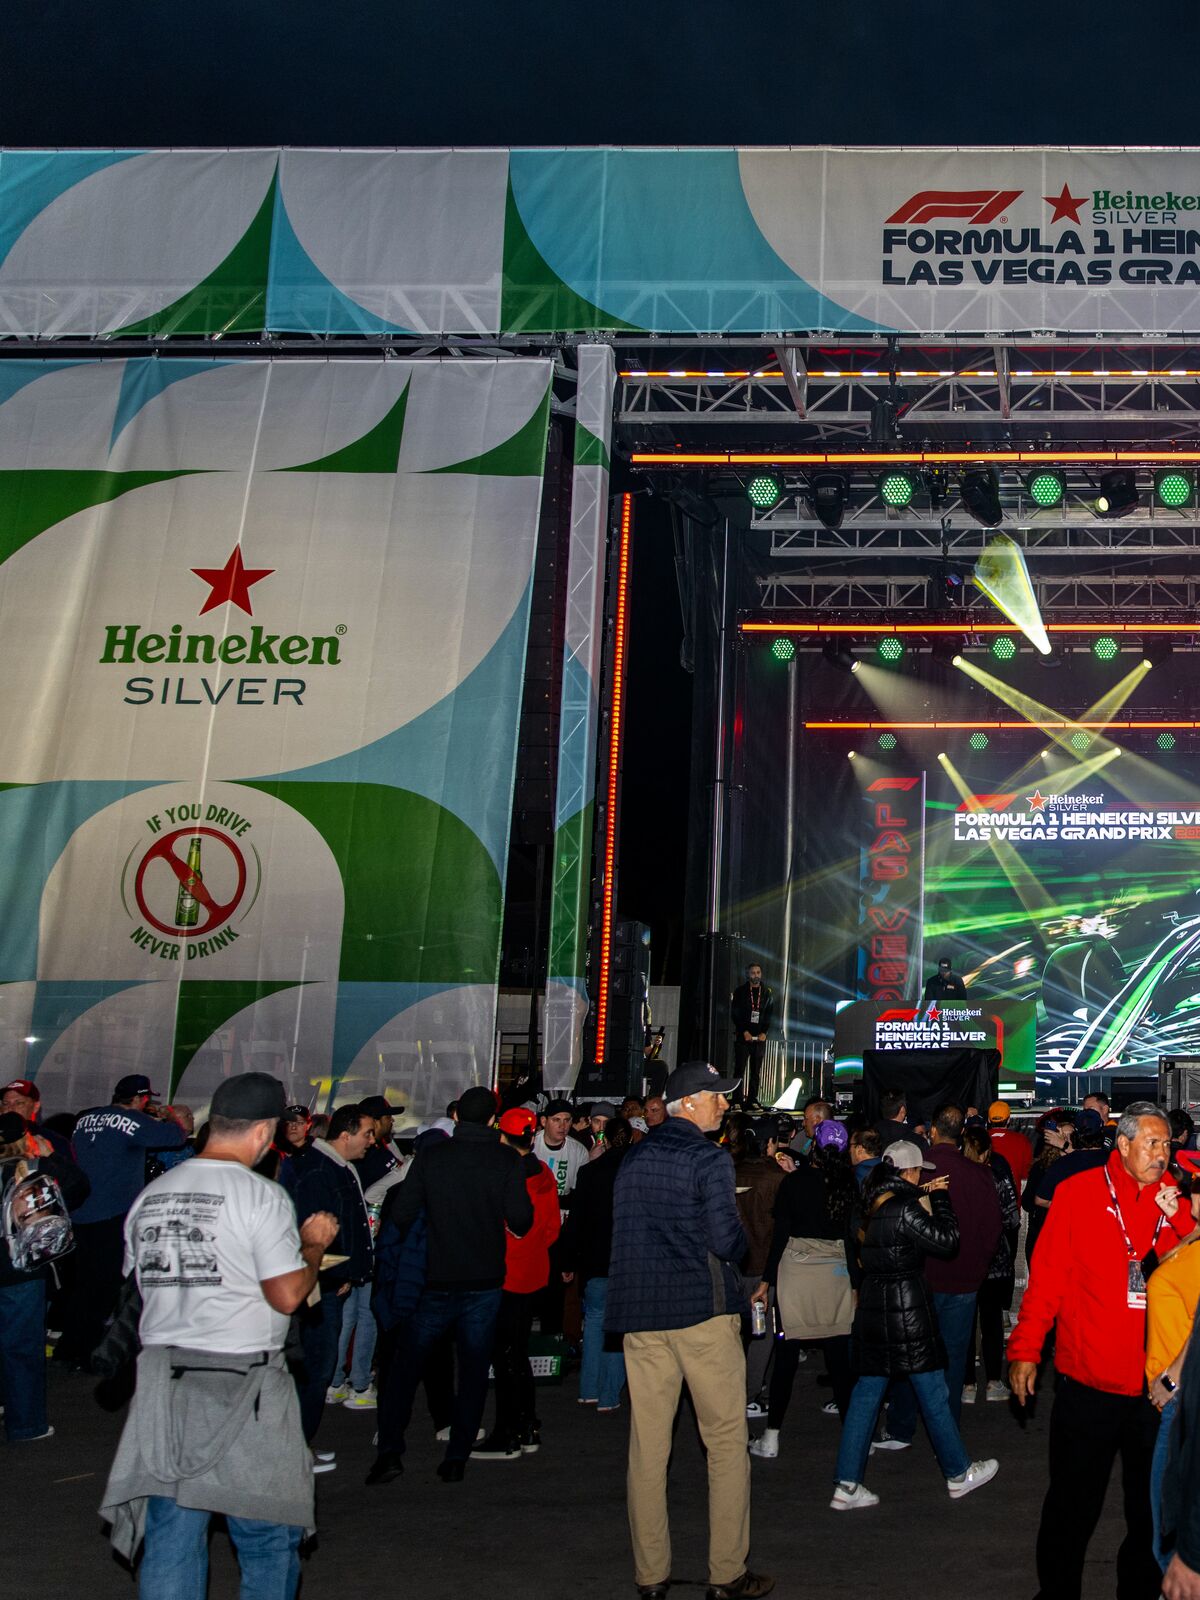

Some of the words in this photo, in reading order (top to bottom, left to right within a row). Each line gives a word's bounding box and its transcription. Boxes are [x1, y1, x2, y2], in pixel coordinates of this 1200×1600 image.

[1092, 212, 1177, 225] SILVER
[883, 229, 1084, 254] FORMULA
[1094, 229, 1114, 254] 1
[883, 259, 963, 285] LAS
[970, 259, 1112, 285] VEGAS
[99, 624, 341, 665] Heineken
[124, 677, 307, 706] SILVER
[1049, 794, 1102, 804] Heineken
[146, 815, 163, 834] IF
[165, 804, 201, 825] YOU
[205, 804, 252, 838] DRIVE
[955, 813, 1045, 825] FORMULA
[1049, 813, 1059, 825] 1
[1062, 812, 1153, 825] HEINEKEN
[869, 803, 911, 880] LAS
[955, 827, 991, 840] LAS
[995, 827, 1058, 840] VEGAS
[1061, 827, 1126, 840] GRAND
[1132, 827, 1172, 839] PRIX
[130, 926, 180, 960] NEVER
[187, 925, 240, 960] DRINK
[942, 1008, 981, 1016] Heineken
[876, 1022, 940, 1032] FORMULA
[943, 1022, 950, 1031] 1
[876, 1032, 940, 1041] HEINEKEN
[942, 1031, 986, 1041] SILVER
[876, 1042, 902, 1050] LAS
[98, 1113, 141, 1136] SHORE
